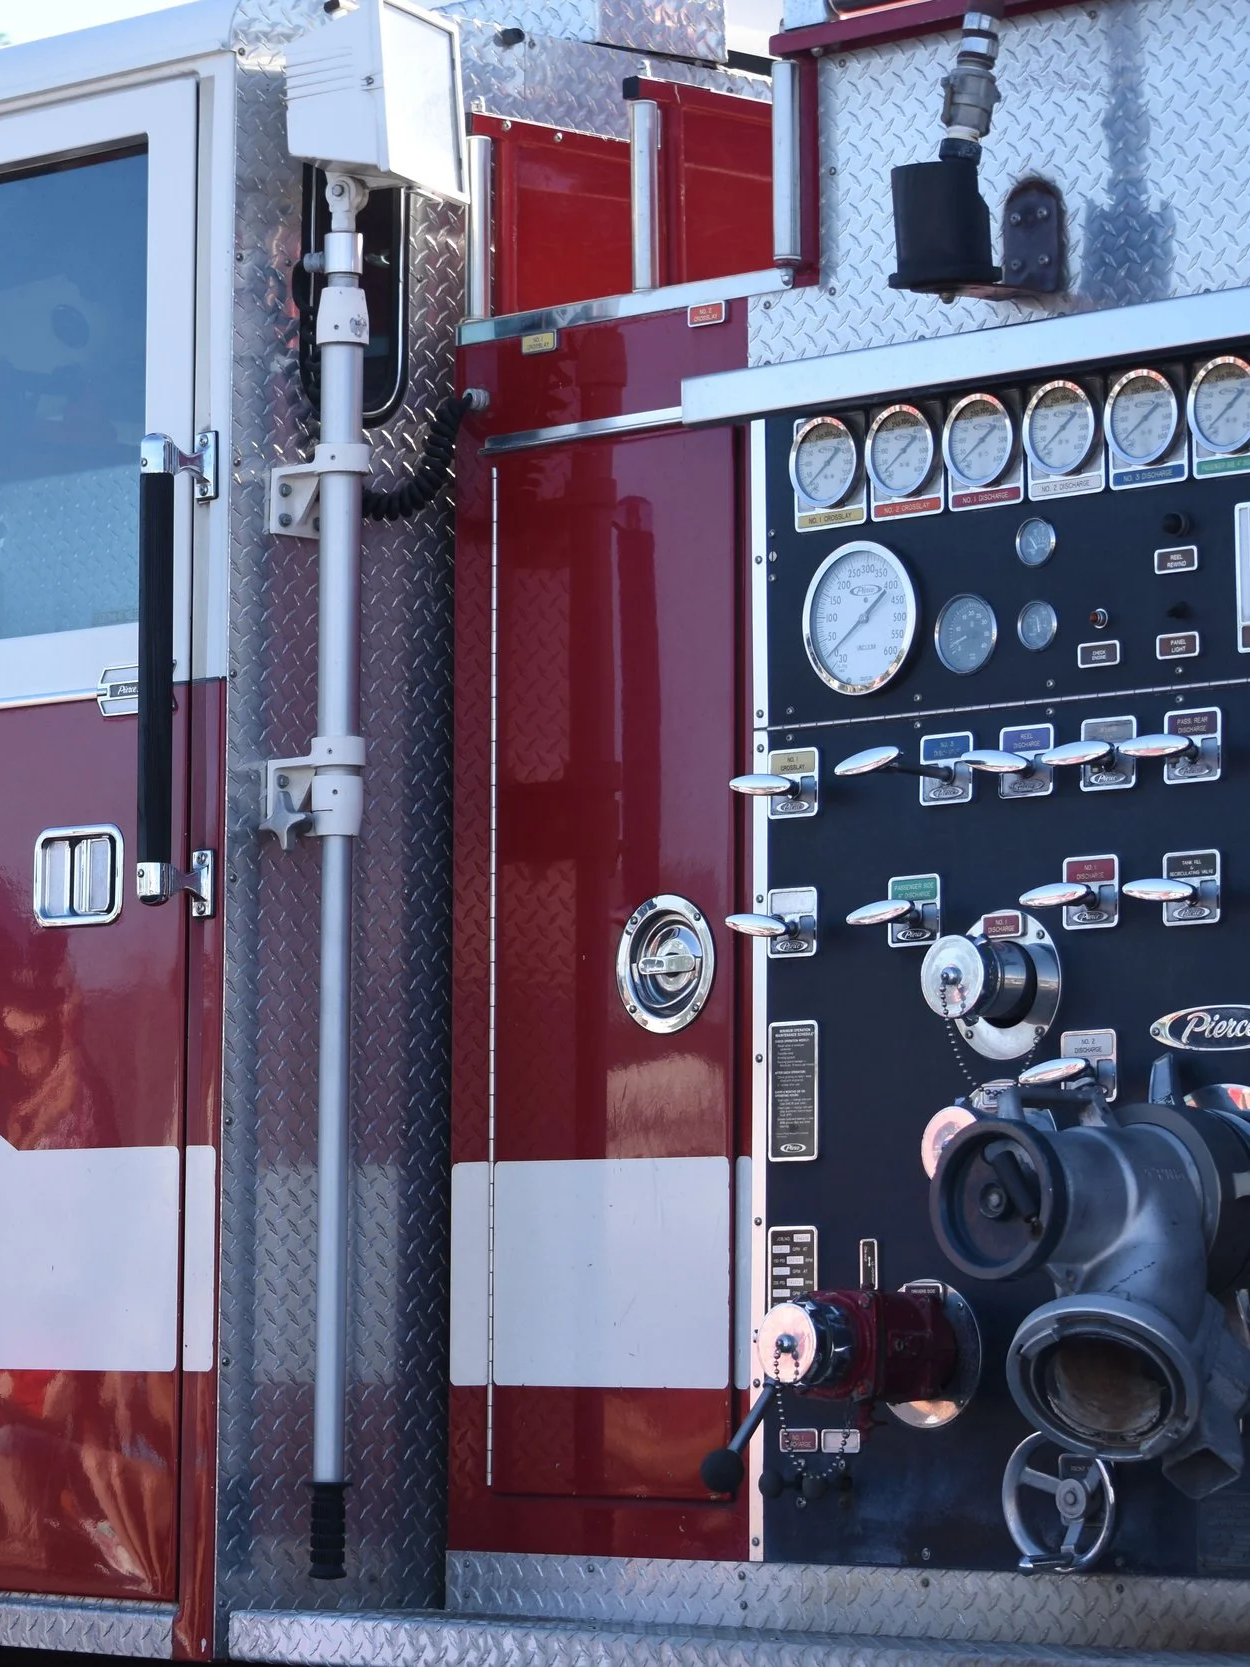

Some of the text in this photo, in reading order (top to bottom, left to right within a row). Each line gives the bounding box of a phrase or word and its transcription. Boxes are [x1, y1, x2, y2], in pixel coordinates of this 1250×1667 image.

[1141, 468, 1173, 480] DISCHARGE
[1059, 480, 1090, 490] DISCHARGE
[978, 491, 1009, 502] DISCHARGE
[901, 501, 930, 512] CROSSLAY
[824, 512, 852, 523] CROSSLAY
[848, 569, 861, 578] 250
[861, 565, 874, 574] 300
[874, 569, 888, 578] 350
[837, 580, 851, 589] 200
[884, 580, 898, 589] 400
[830, 595, 842, 605] 150
[891, 596, 904, 604] 450
[825, 613, 838, 622] 100
[893, 612, 907, 621] 500
[828, 632, 837, 641] 50
[891, 629, 904, 639] 550
[883, 647, 898, 656] 600
[838, 653, 848, 663] 30
[1194, 716, 1208, 724] REAR
[1178, 725, 1207, 734] DISCHARGE
[1013, 740, 1041, 749] DISCHARGE
[780, 764, 805, 772] CROSSLAY
[1076, 871, 1105, 881] DISCHARGE
[987, 924, 1015, 933] DISCHARGE
